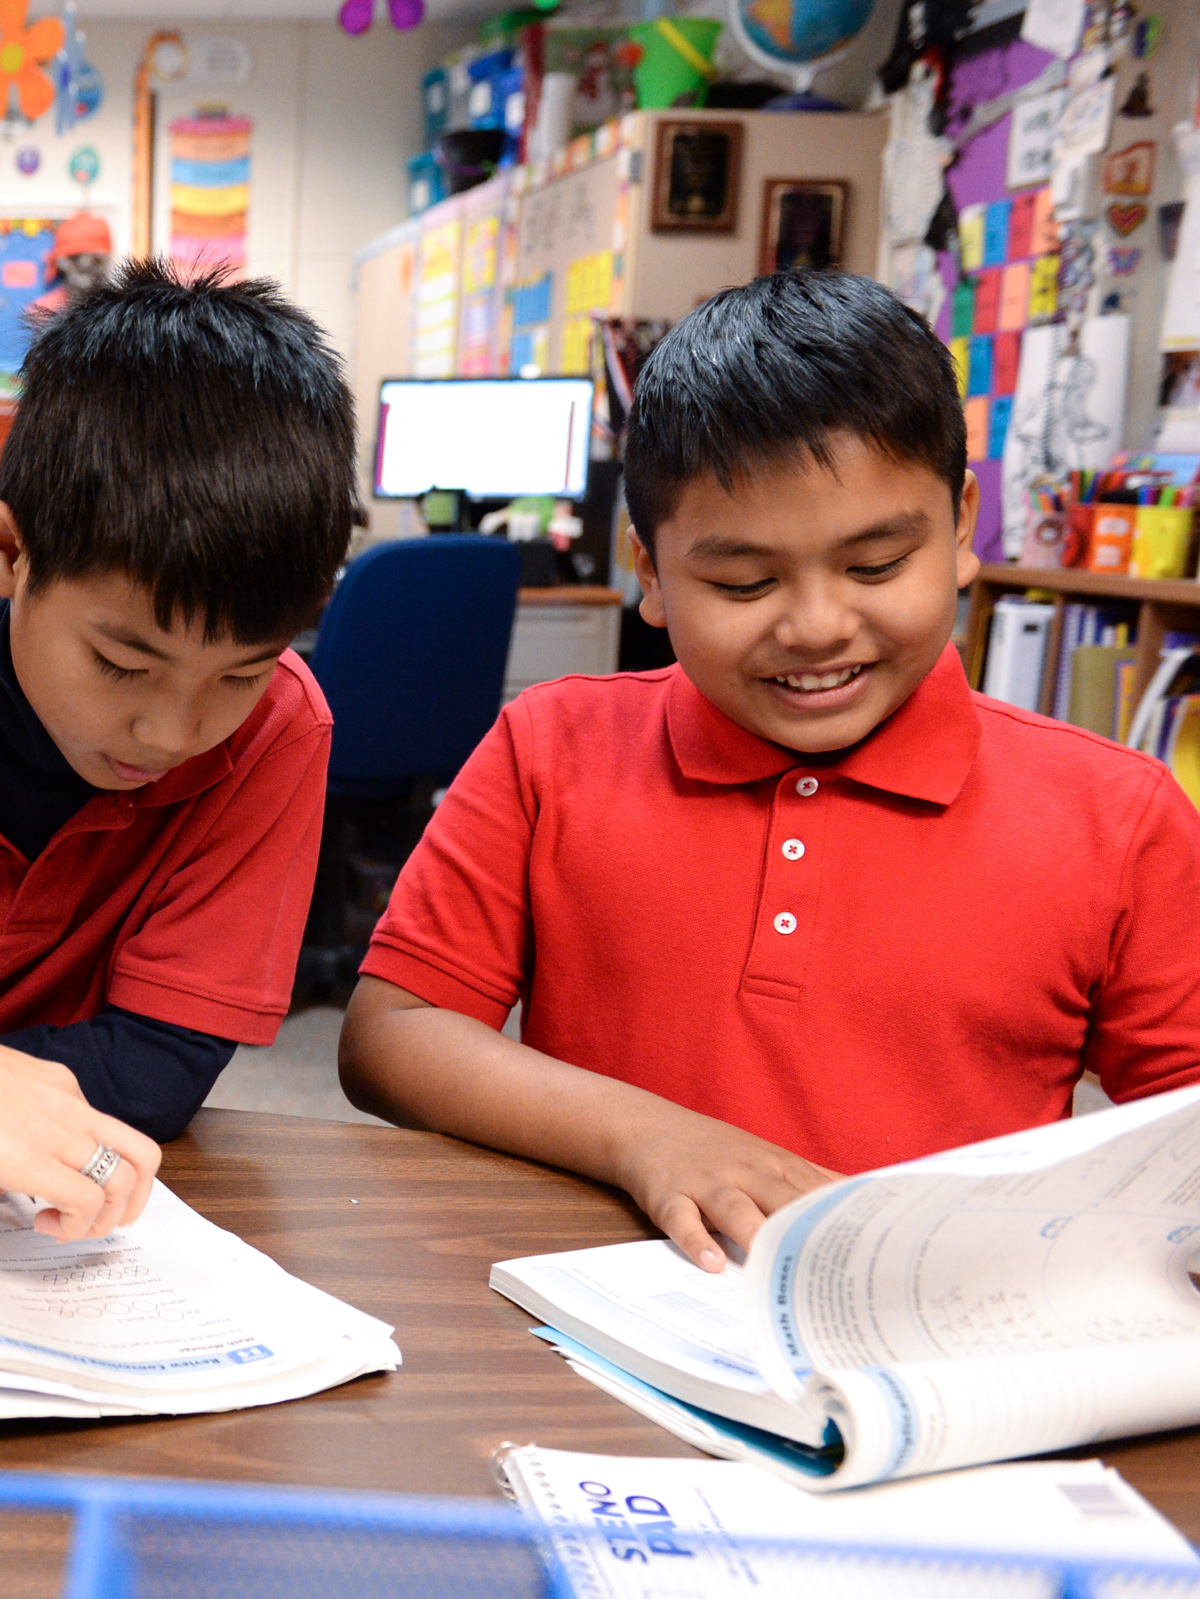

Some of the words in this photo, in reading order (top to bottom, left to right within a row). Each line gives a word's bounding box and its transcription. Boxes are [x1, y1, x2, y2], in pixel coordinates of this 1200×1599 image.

[778, 1255, 793, 1306] Boxes
[225, 1337, 256, 1346] Math
[780, 1313, 800, 1357] Math
[23, 1342, 87, 1363] Fractions
[176, 1344, 226, 1352] Message
[89, 1357, 166, 1371] Converting
[170, 1357, 221, 1369] Review
[579, 1481, 648, 1563] STENO
[625, 1495, 696, 1557] PAD
